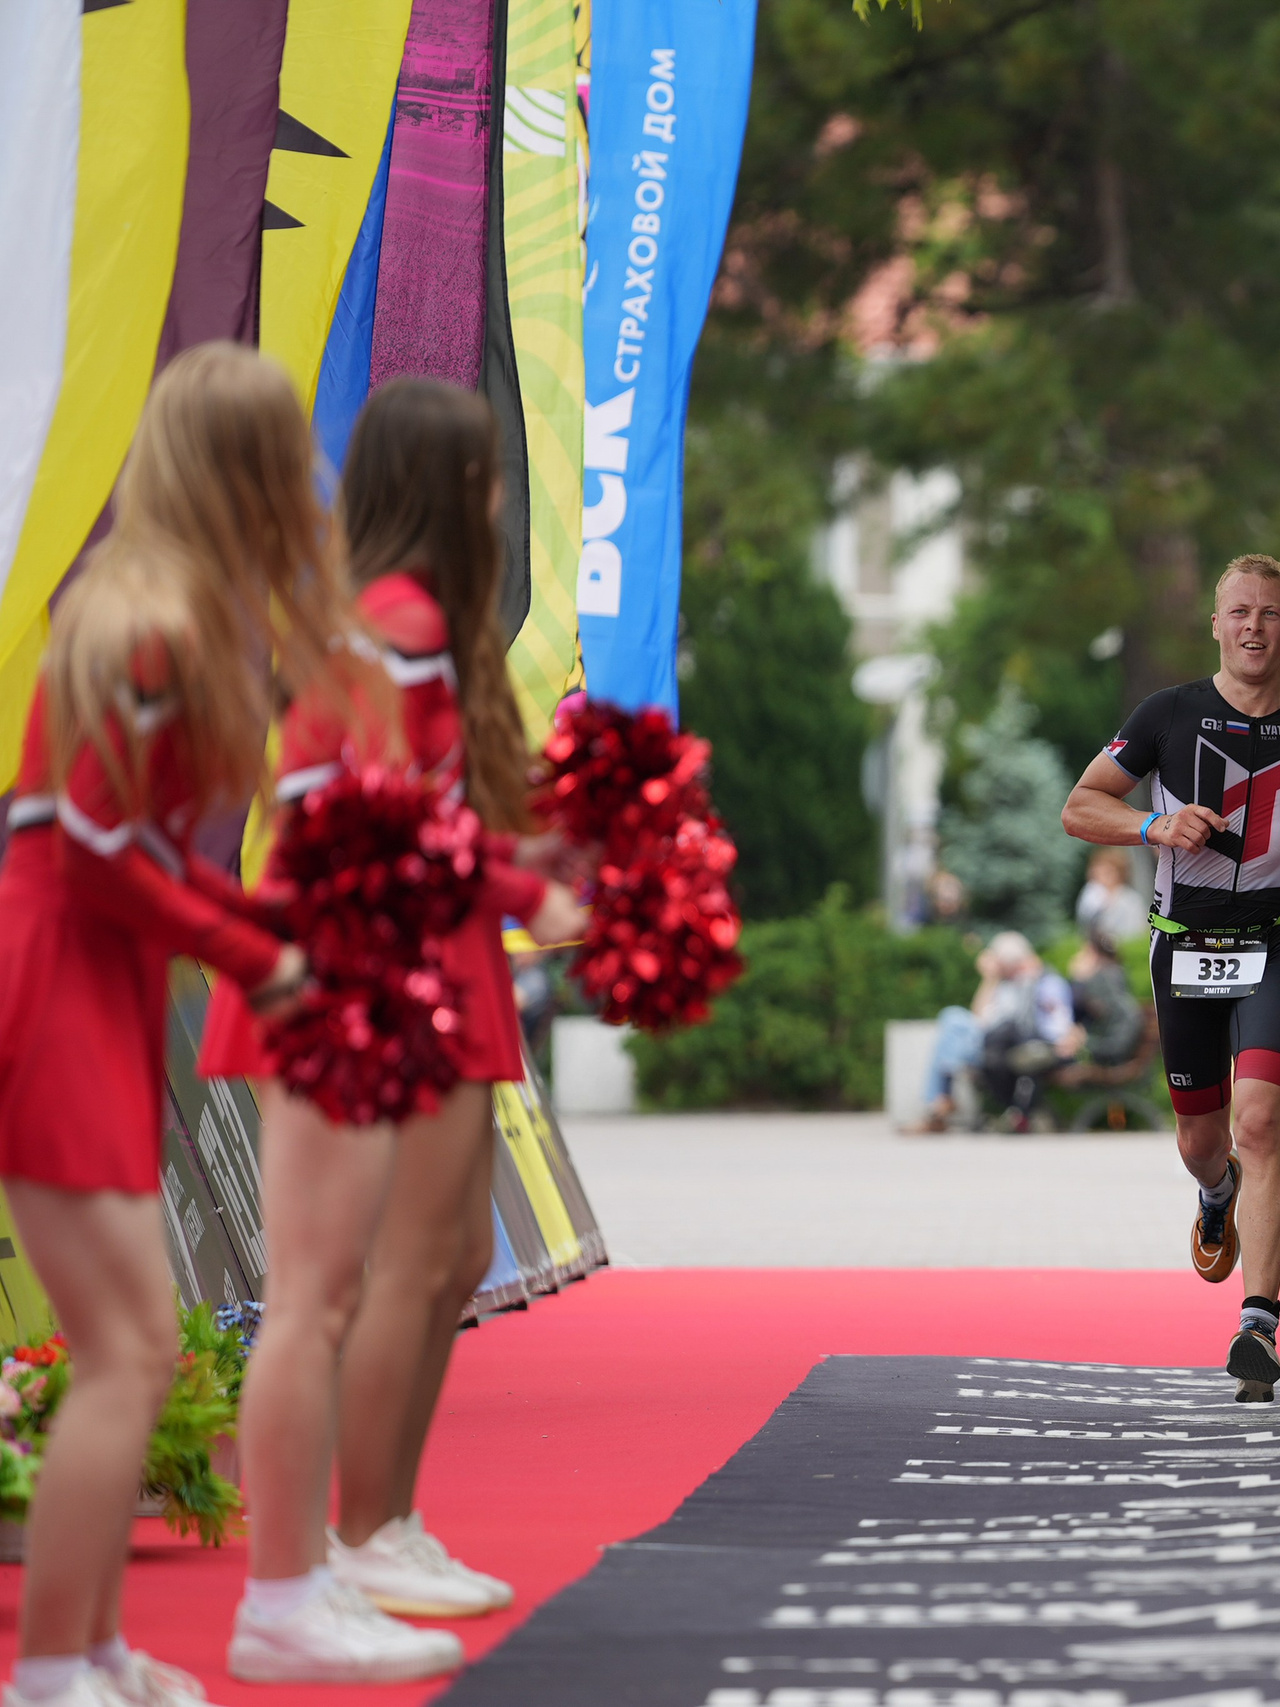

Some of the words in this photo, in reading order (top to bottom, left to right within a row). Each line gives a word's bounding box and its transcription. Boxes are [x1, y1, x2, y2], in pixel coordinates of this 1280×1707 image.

[613, 150, 668, 383] СТРАХОВОЙ
[642, 48, 676, 144] ДОМ
[1198, 958, 1241, 980] 332
[932, 1426, 1189, 1439] IRON
